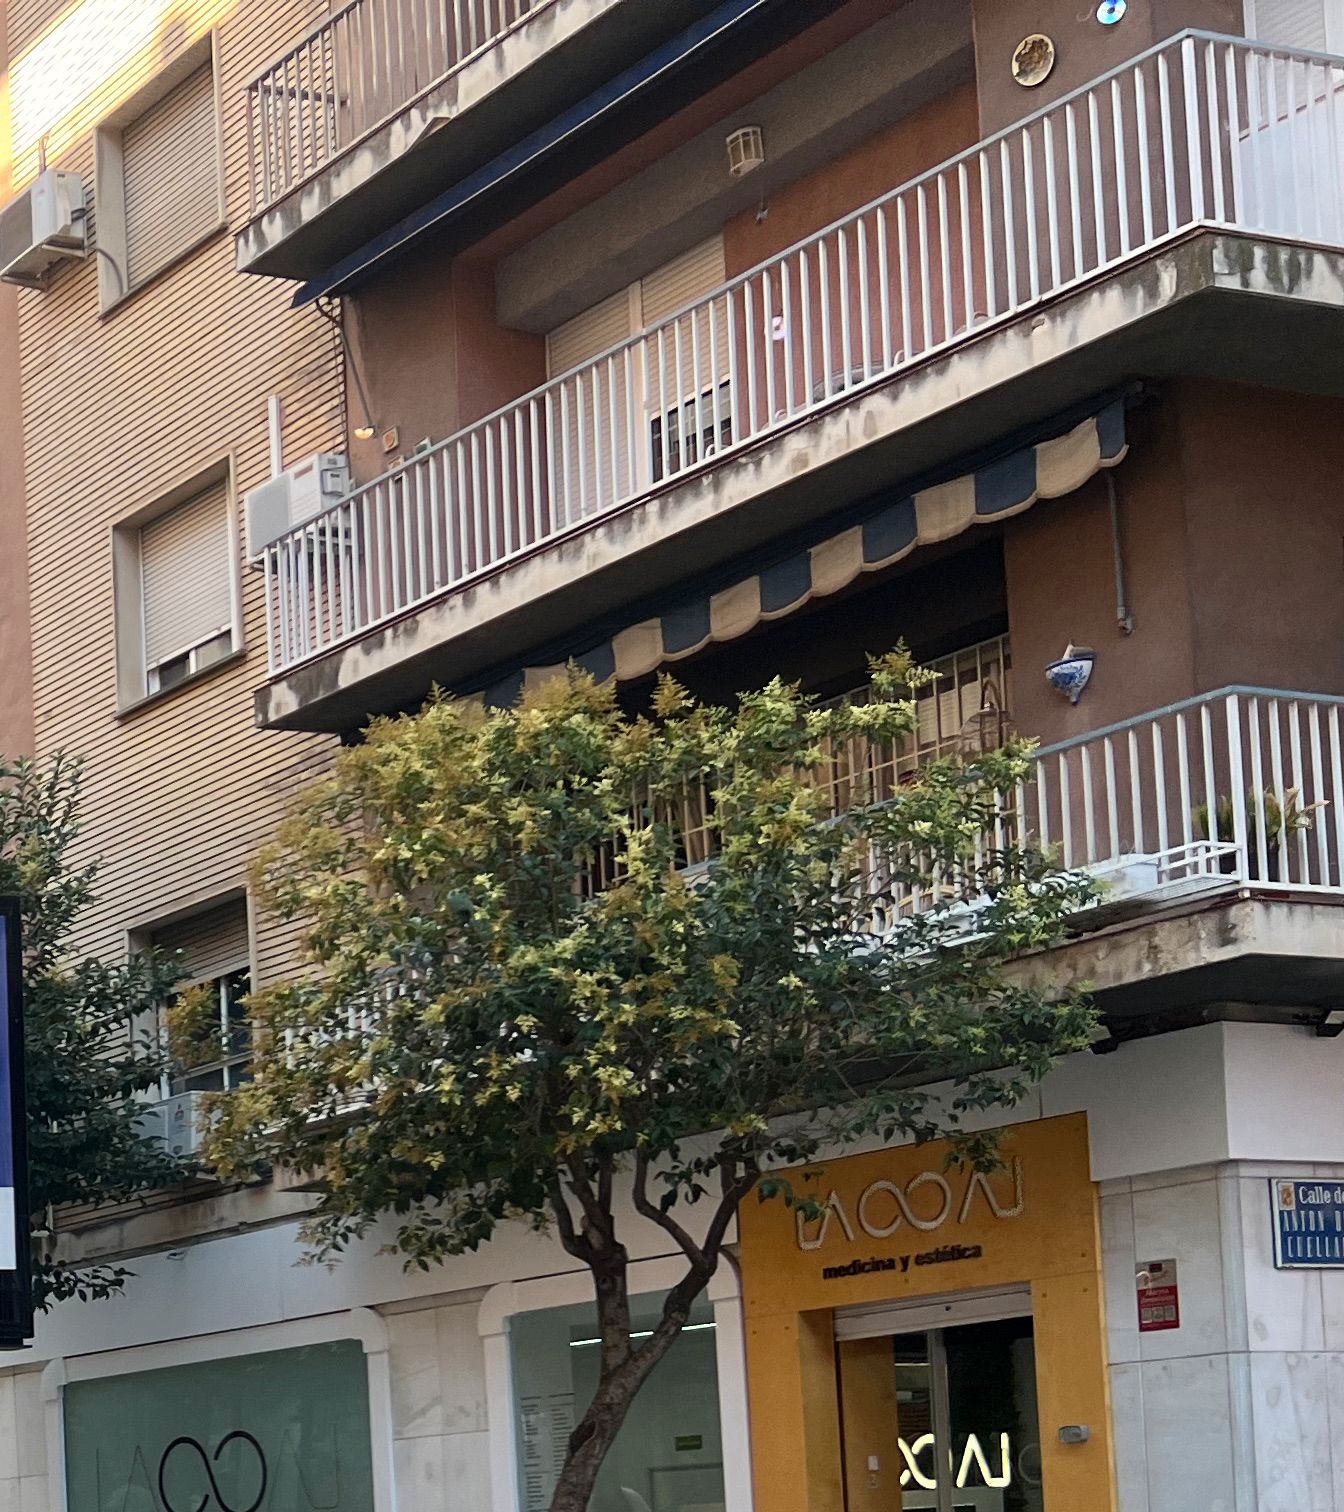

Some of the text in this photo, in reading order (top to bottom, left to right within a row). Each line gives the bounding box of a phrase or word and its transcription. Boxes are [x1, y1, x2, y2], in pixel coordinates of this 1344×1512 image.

[1298, 1185, 1331, 1204] Calle
[1287, 1236, 1344, 1258] CUELLA
[823, 1243, 983, 1280] medicina y estética
